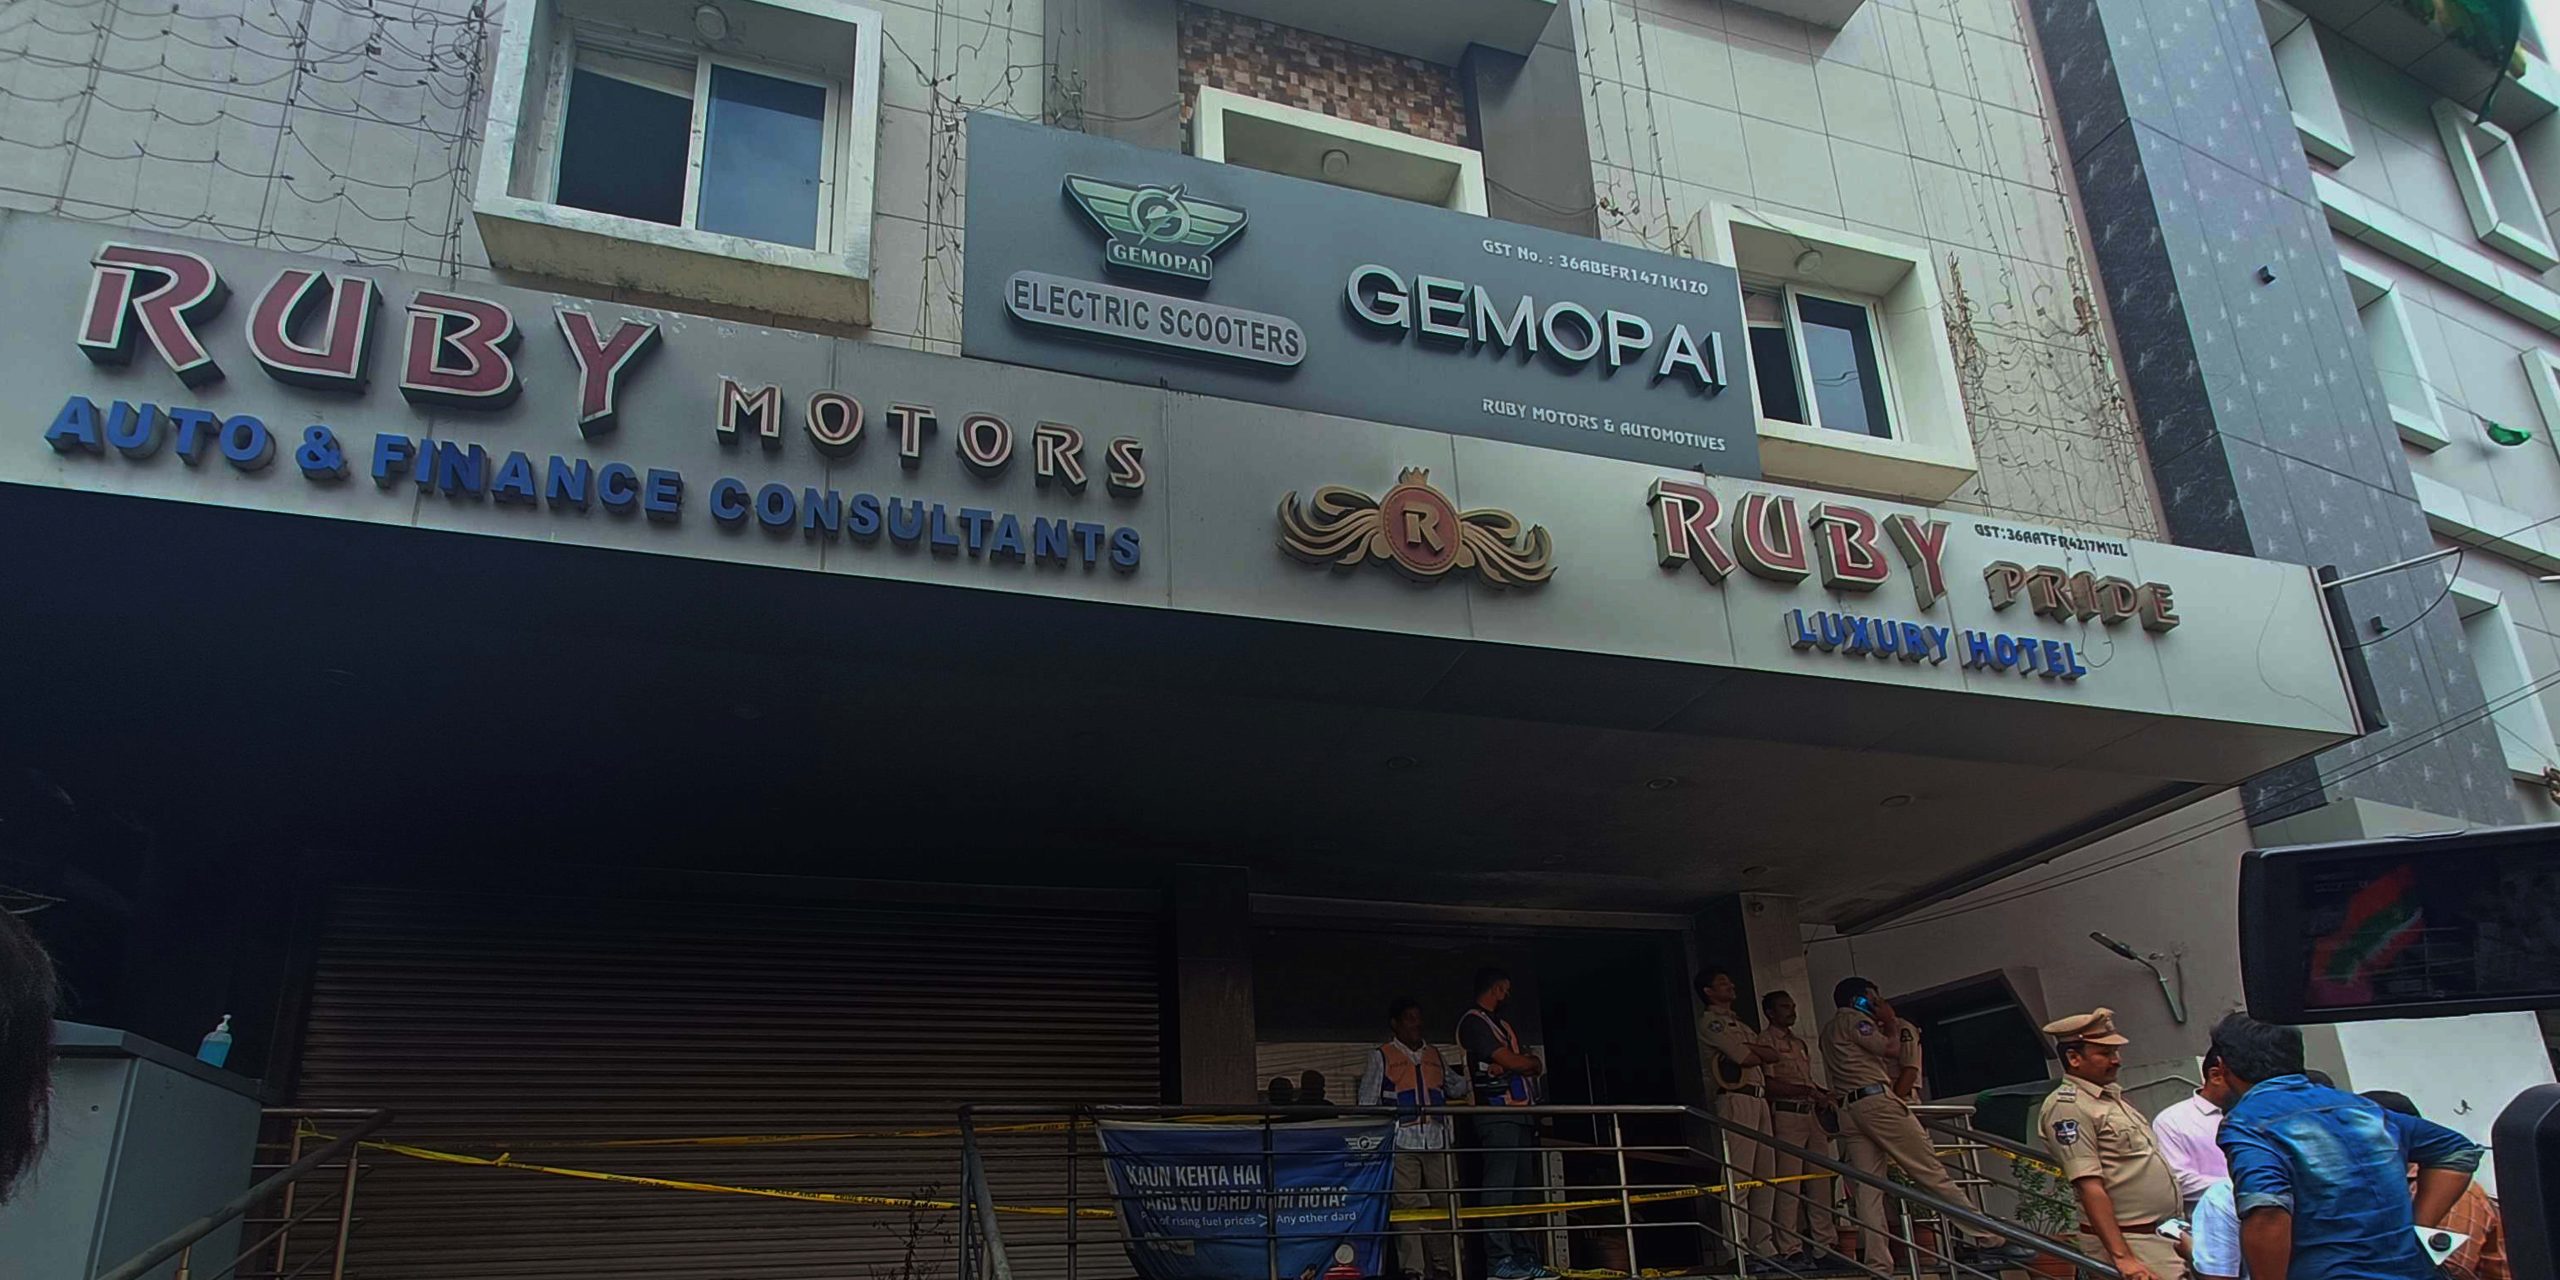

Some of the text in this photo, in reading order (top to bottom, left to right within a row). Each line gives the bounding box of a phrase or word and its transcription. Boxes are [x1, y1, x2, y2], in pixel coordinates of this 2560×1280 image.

[1113, 243, 1208, 275] GEMOPAI
[1482, 239, 1512, 257] GST
[1518, 246, 1543, 263] No.
[1013, 277, 1299, 357] ELECTRIC SCOOTERS
[1345, 263, 1728, 390] GEMOPAI
[78, 241, 1147, 495] RUBY MOTORS
[1482, 398, 1727, 451] RUBY MOTORS & AUTOMOTIVES
[45, 396, 1141, 572] AUTO & FINANCE CONSULTANTS
[1403, 504, 1444, 553] R
[1647, 477, 2180, 633] RUBY PRIDE
[1784, 608, 2088, 681] LUXURY HOTEL
[1126, 1164, 1262, 1187] KAUN KEHTA HAI
[1172, 1214, 1201, 1228] rising
[1202, 1213, 1221, 1226] fuel
[1224, 1213, 1257, 1228] prices
[1276, 1213, 1296, 1226] Any
[1299, 1211, 1329, 1224] other
[1331, 1211, 1357, 1222] dard
